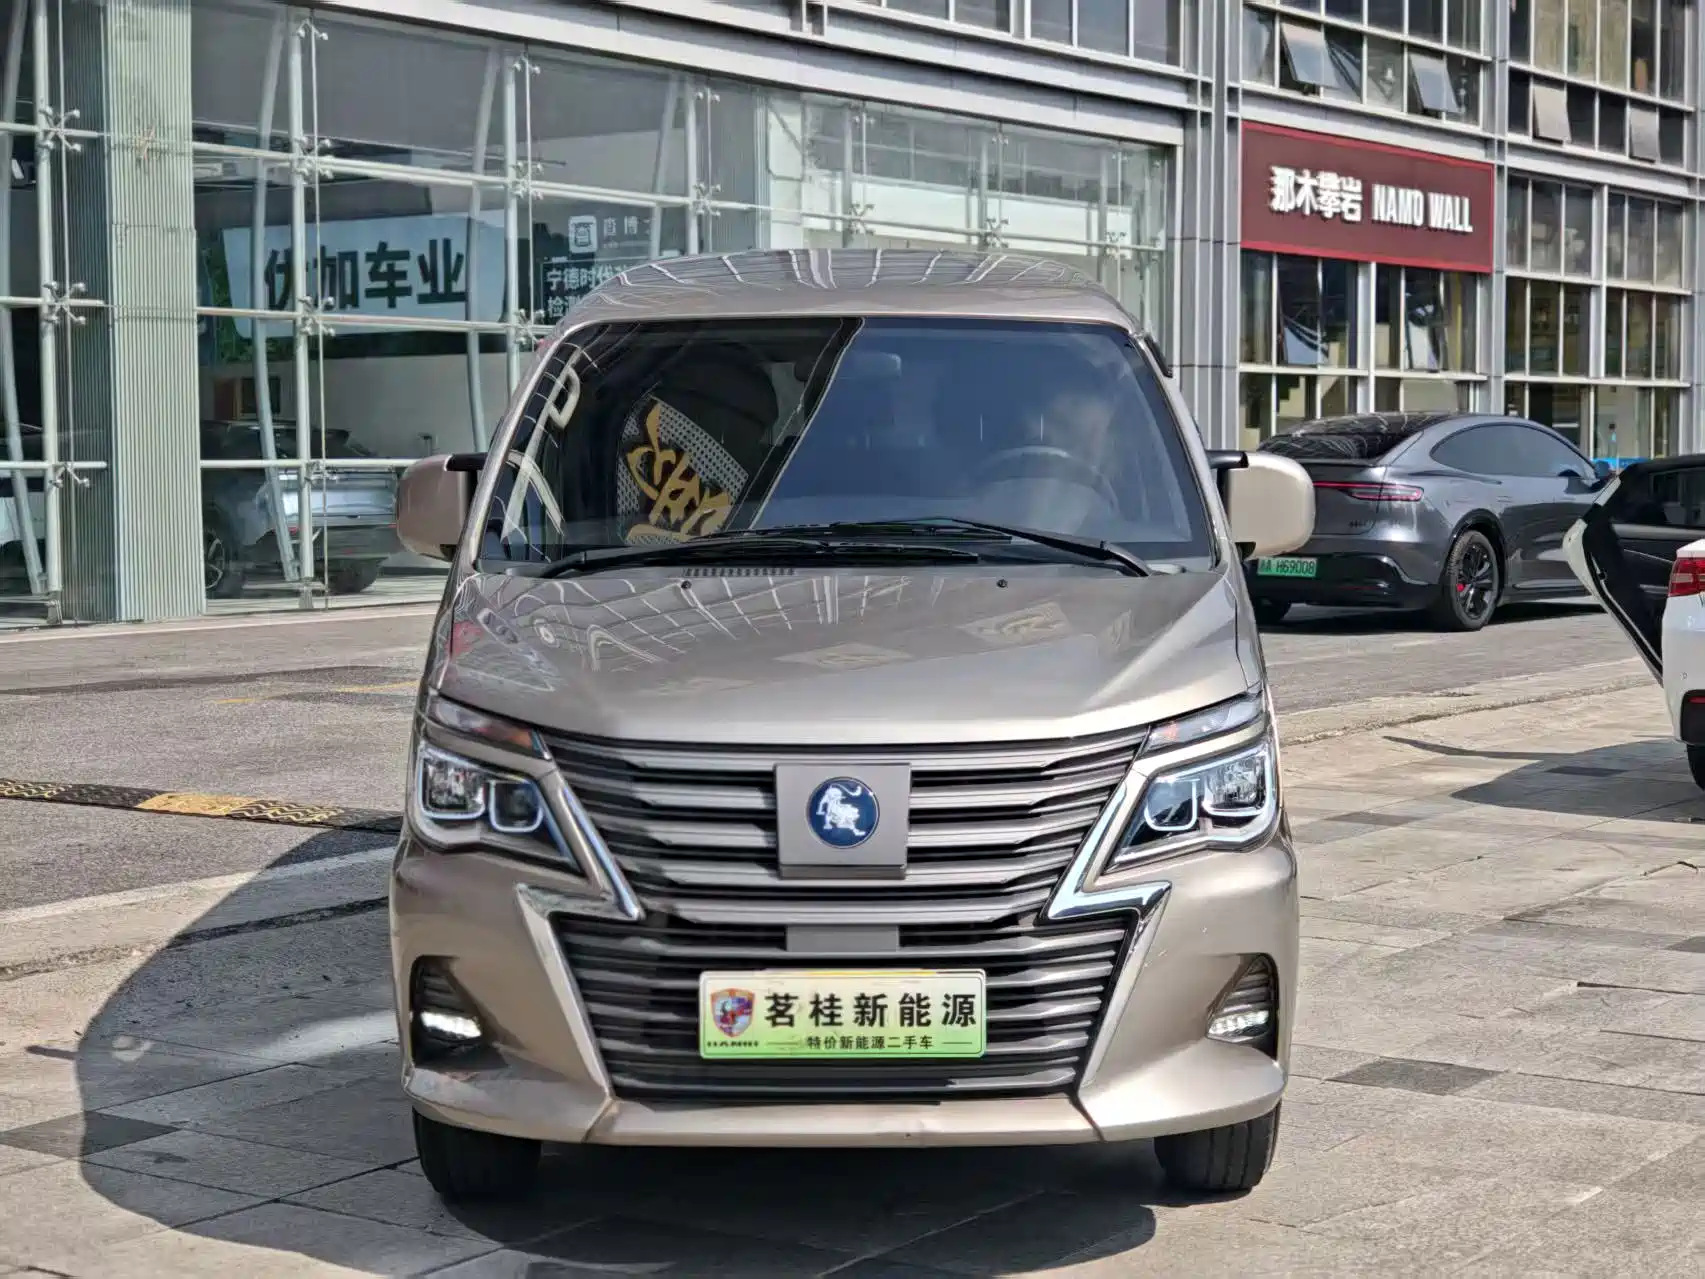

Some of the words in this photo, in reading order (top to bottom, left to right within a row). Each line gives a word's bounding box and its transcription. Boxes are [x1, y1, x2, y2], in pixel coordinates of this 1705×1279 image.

[1271, 165, 1363, 222] 那木攀岩
[1371, 183, 1425, 227] NAMO
[1428, 191, 1474, 233] WALL
[764, 992, 977, 1028] 茗桂新能源
[807, 1035, 934, 1050] 特价新能源二手车
